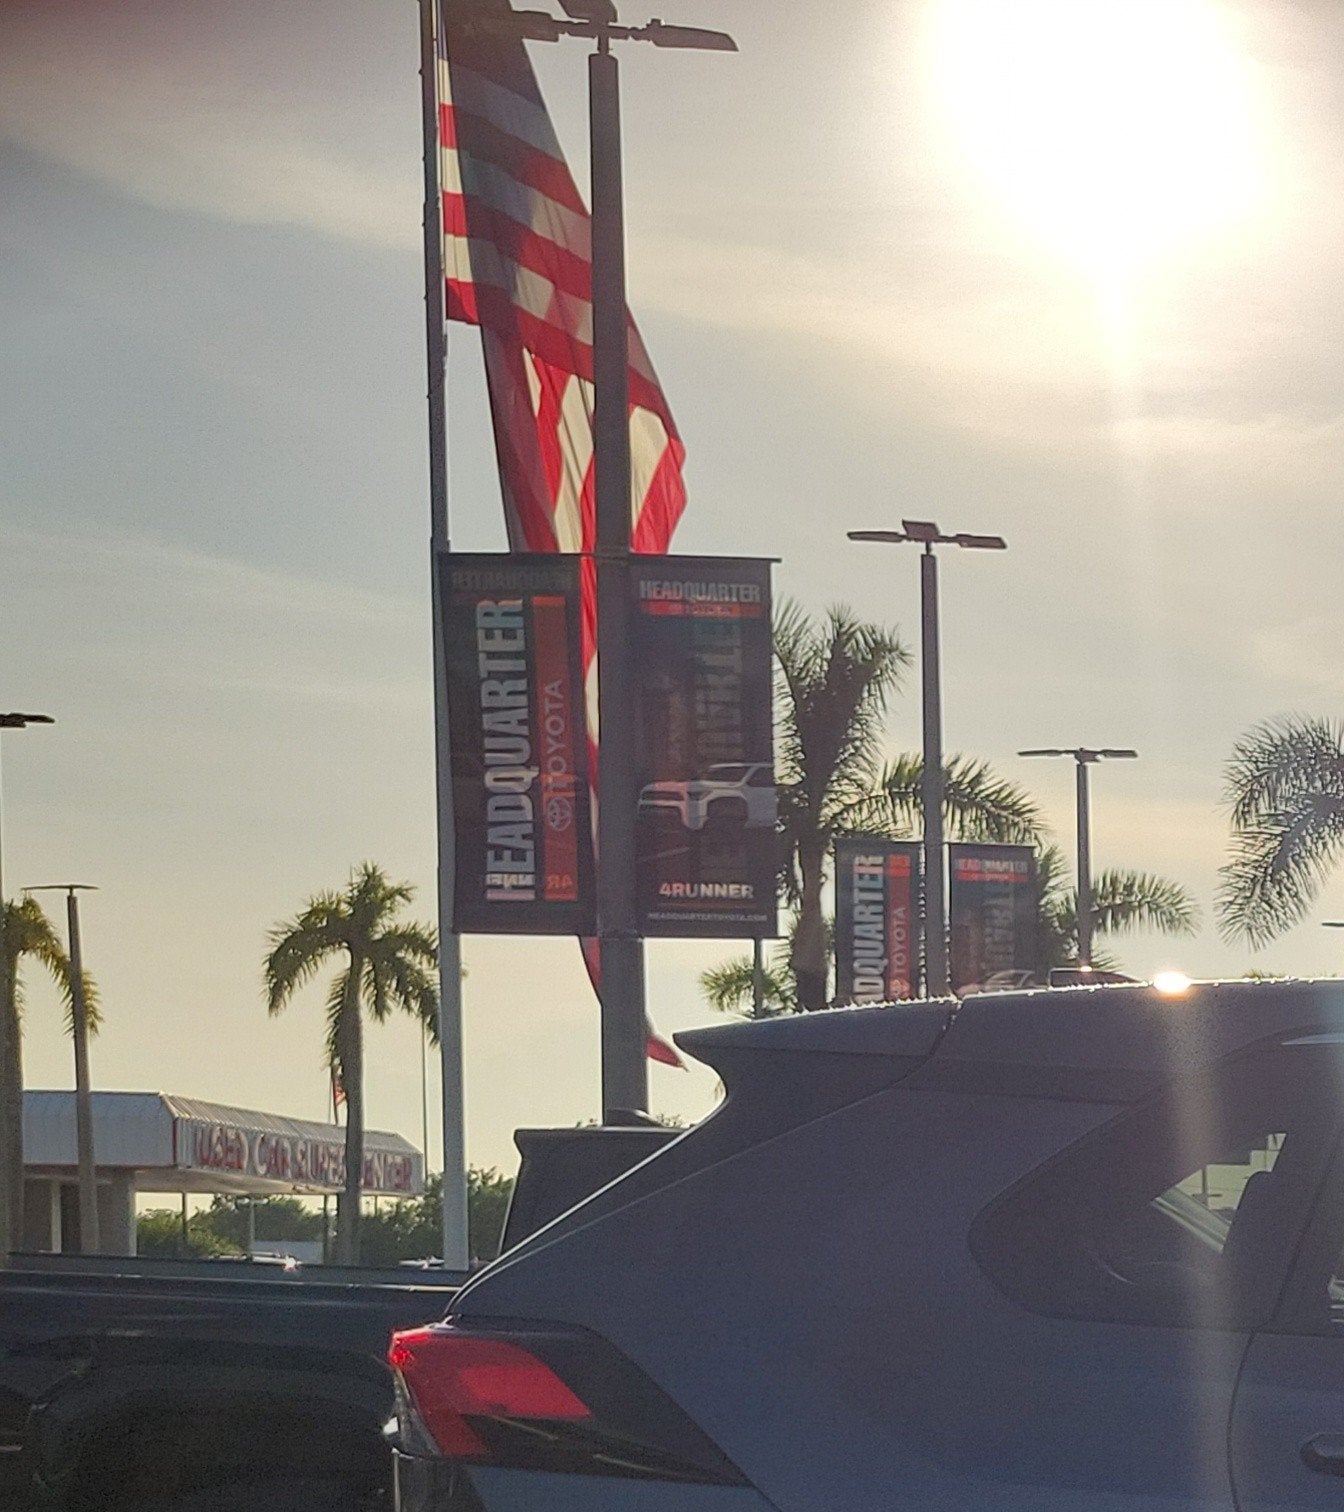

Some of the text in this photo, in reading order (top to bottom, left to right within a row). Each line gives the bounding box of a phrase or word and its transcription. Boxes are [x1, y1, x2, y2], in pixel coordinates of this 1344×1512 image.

[475, 599, 539, 900] HEADQUARTER
[544, 679, 568, 788] TOYOTA
[659, 882, 754, 899] 4RUNNER
[894, 907, 907, 974] TOYOTA
[197, 1125, 249, 1171] USED
[254, 1132, 292, 1180] CAR
[361, 1150, 413, 1193] ENTER
